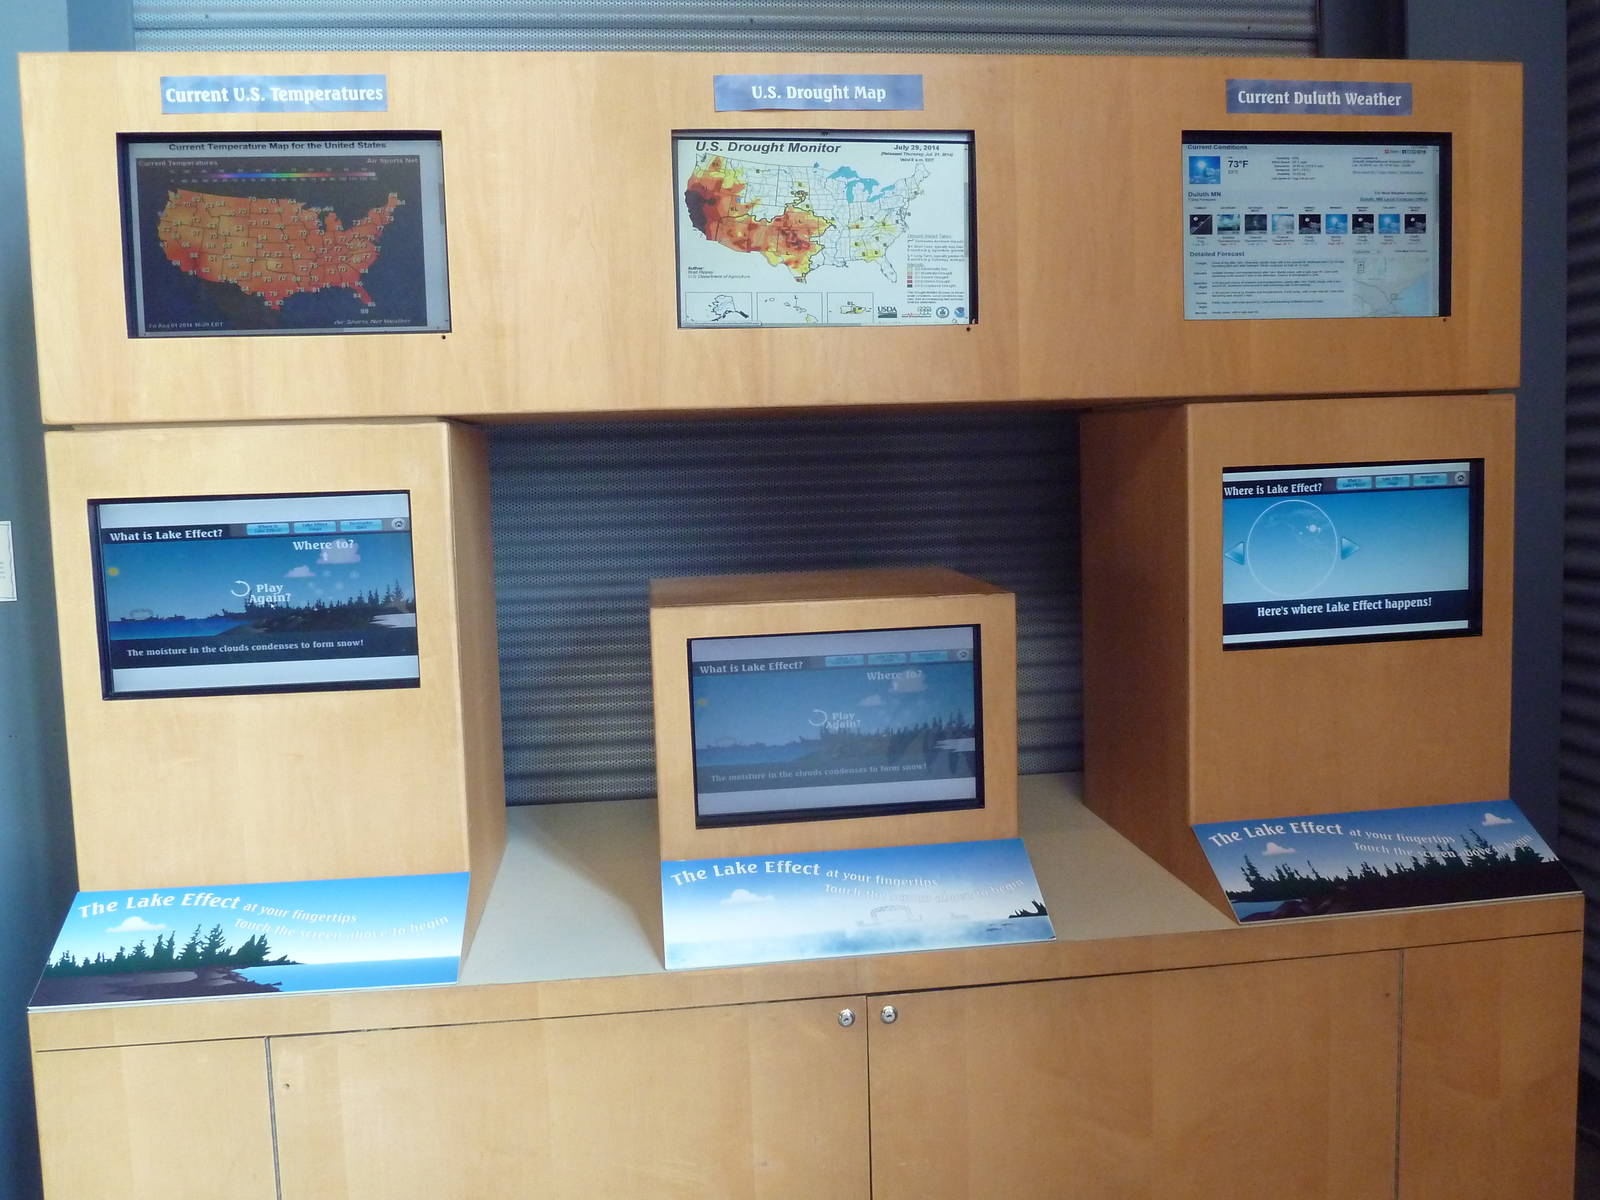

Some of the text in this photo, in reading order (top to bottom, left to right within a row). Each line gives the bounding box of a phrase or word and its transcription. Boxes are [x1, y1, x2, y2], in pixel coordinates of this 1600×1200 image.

[165, 86, 383, 105] Current U.S. Temperatures
[751, 84, 887, 103] U.S. Drought Map
[1237, 90, 1402, 106] Current Duluth Weather
[169, 143, 205, 151] Current
[208, 142, 267, 151] Temperature
[269, 142, 289, 151] Map
[325, 141, 355, 149] United
[695, 141, 841, 155] U.S. Drought Monitor
[894, 144, 909, 152] July
[1227, 160, 1249, 168] 73°F
[1224, 482, 1322, 496] Where is Lake Effect?
[110, 529, 223, 541] What is Lake Effect?
[292, 539, 355, 551] Where to?
[256, 583, 283, 594] Play
[249, 592, 292, 605] Again?
[1257, 596, 1433, 617] Here's where Lake Effect happens!
[127, 639, 364, 657] The moisture in the clouds condenses to form snow!
[700, 661, 804, 674] What is Lake Effect?
[866, 671, 902, 681] Where
[832, 711, 856, 721] Play
[825, 719, 862, 730] Again?
[712, 774, 726, 782] The
[779, 770, 793, 778] the
[1208, 821, 1456, 847] The Lake Effect at your fingertips
[1353, 842, 1390, 855] Touch
[669, 859, 938, 888] The Lake Effect at your fingertips
[825, 883, 861, 897] Touch
[78, 891, 359, 925] The Lake Effect at your fingertips
[234, 917, 272, 933] Touch
[274, 925, 296, 937] the
